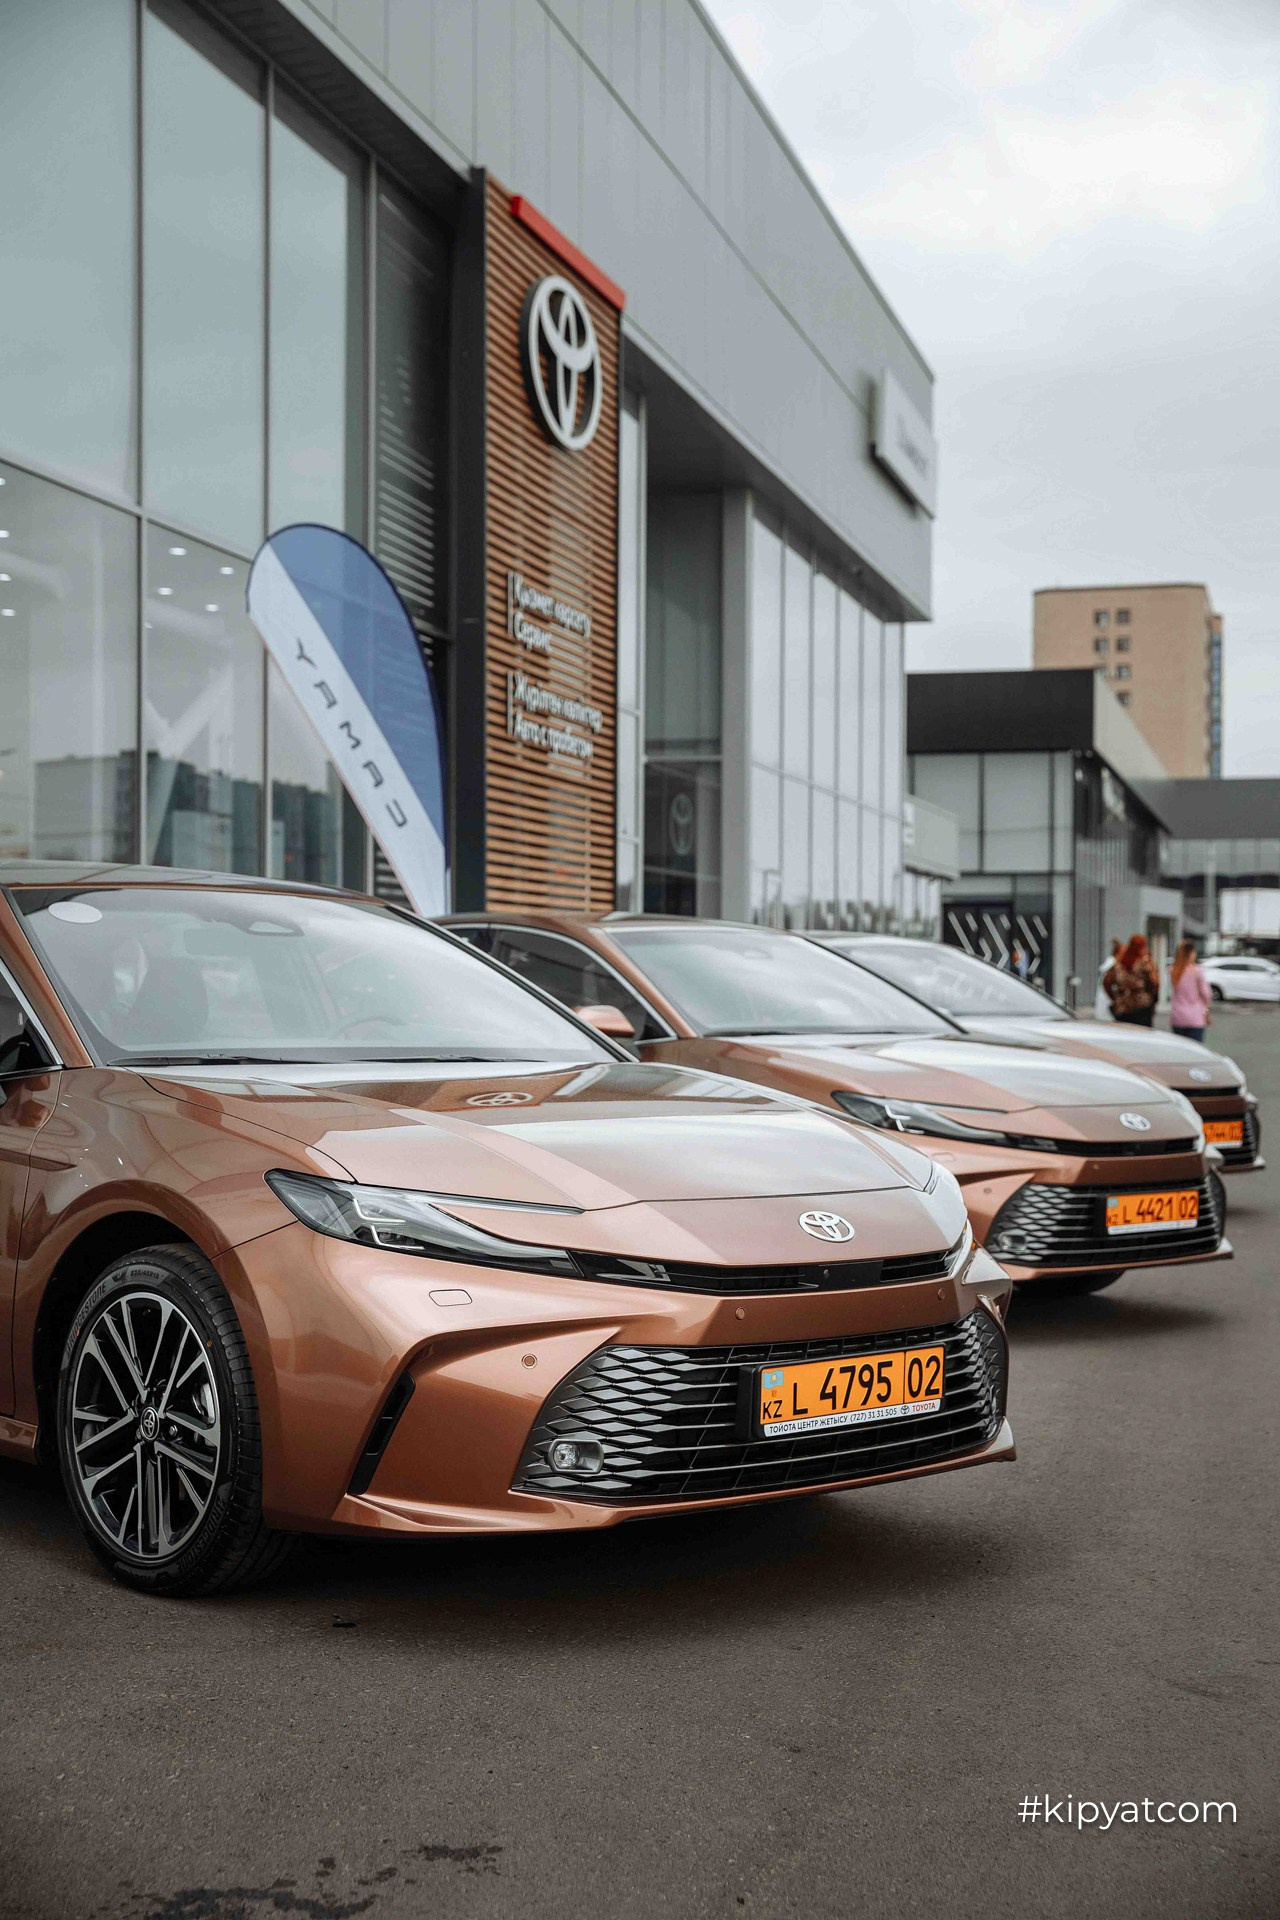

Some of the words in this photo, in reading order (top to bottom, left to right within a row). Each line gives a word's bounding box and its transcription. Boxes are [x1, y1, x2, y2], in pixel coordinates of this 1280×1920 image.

[1122, 1205, 1131, 1223] L
[1136, 1197, 1174, 1222] 4421
[1178, 1195, 1198, 1219] 02
[762, 1400, 783, 1420] KZ
[792, 1382, 809, 1416] L
[819, 1360, 893, 1411] 4795
[907, 1354, 941, 1398] 02
[769, 1422, 797, 1434] ТОЙОТА
[797, 1419, 818, 1431] ЦЕНТР
[819, 1415, 848, 1427] ЖЕТЫСУ
[850, 1412, 867, 1423] (727)
[885, 1407, 898, 1416] 505
[912, 1402, 936, 1412] TOYOTA
